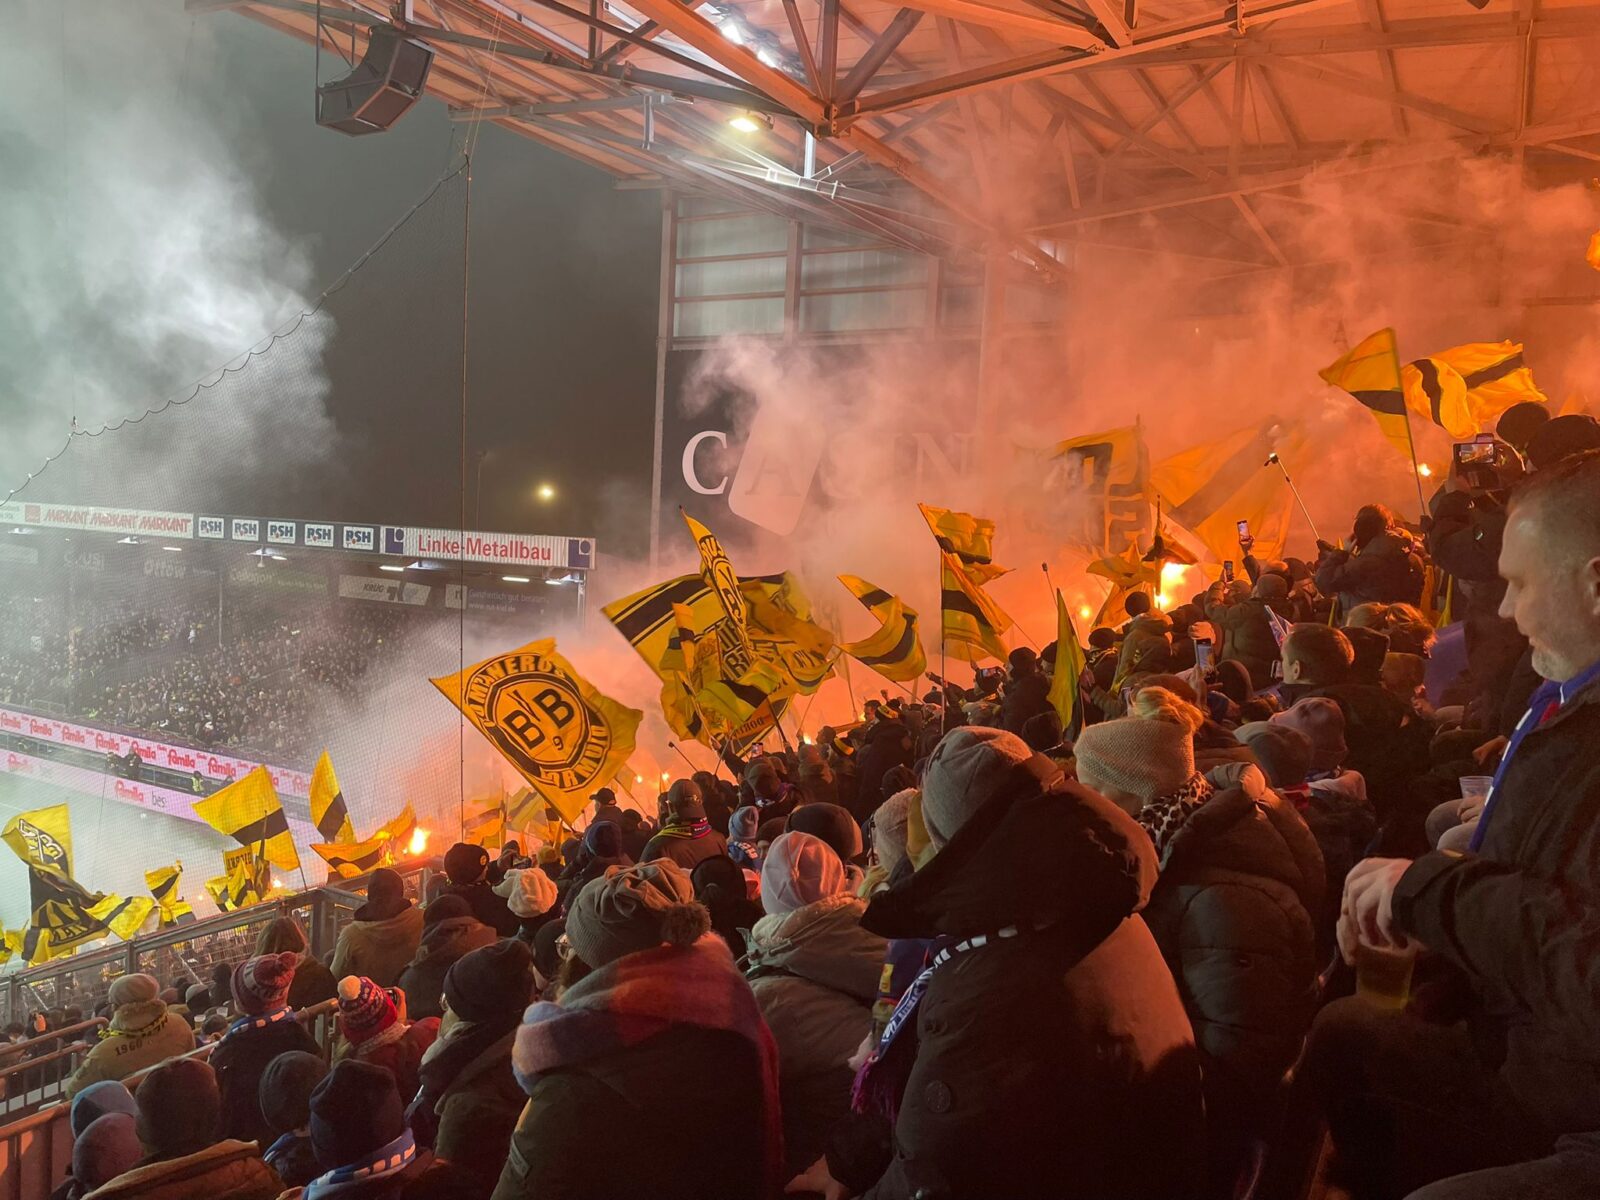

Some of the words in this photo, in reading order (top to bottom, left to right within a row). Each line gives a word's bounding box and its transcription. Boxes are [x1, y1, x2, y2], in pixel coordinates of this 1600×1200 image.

[139, 515, 191, 533] MARKANT
[200, 520, 222, 532] RSH
[235, 522, 257, 534] RSH
[270, 525, 293, 537] RSH
[307, 527, 331, 540] RSH
[346, 530, 370, 543] RSH
[418, 534, 551, 561] Linke-Metallbau
[30, 719, 52, 736] famila
[62, 726, 85, 743] famila
[95, 733, 119, 751] famila
[168, 749, 195, 768] famila
[207, 757, 236, 776] famila
[115, 1039, 143, 1056] 1960
